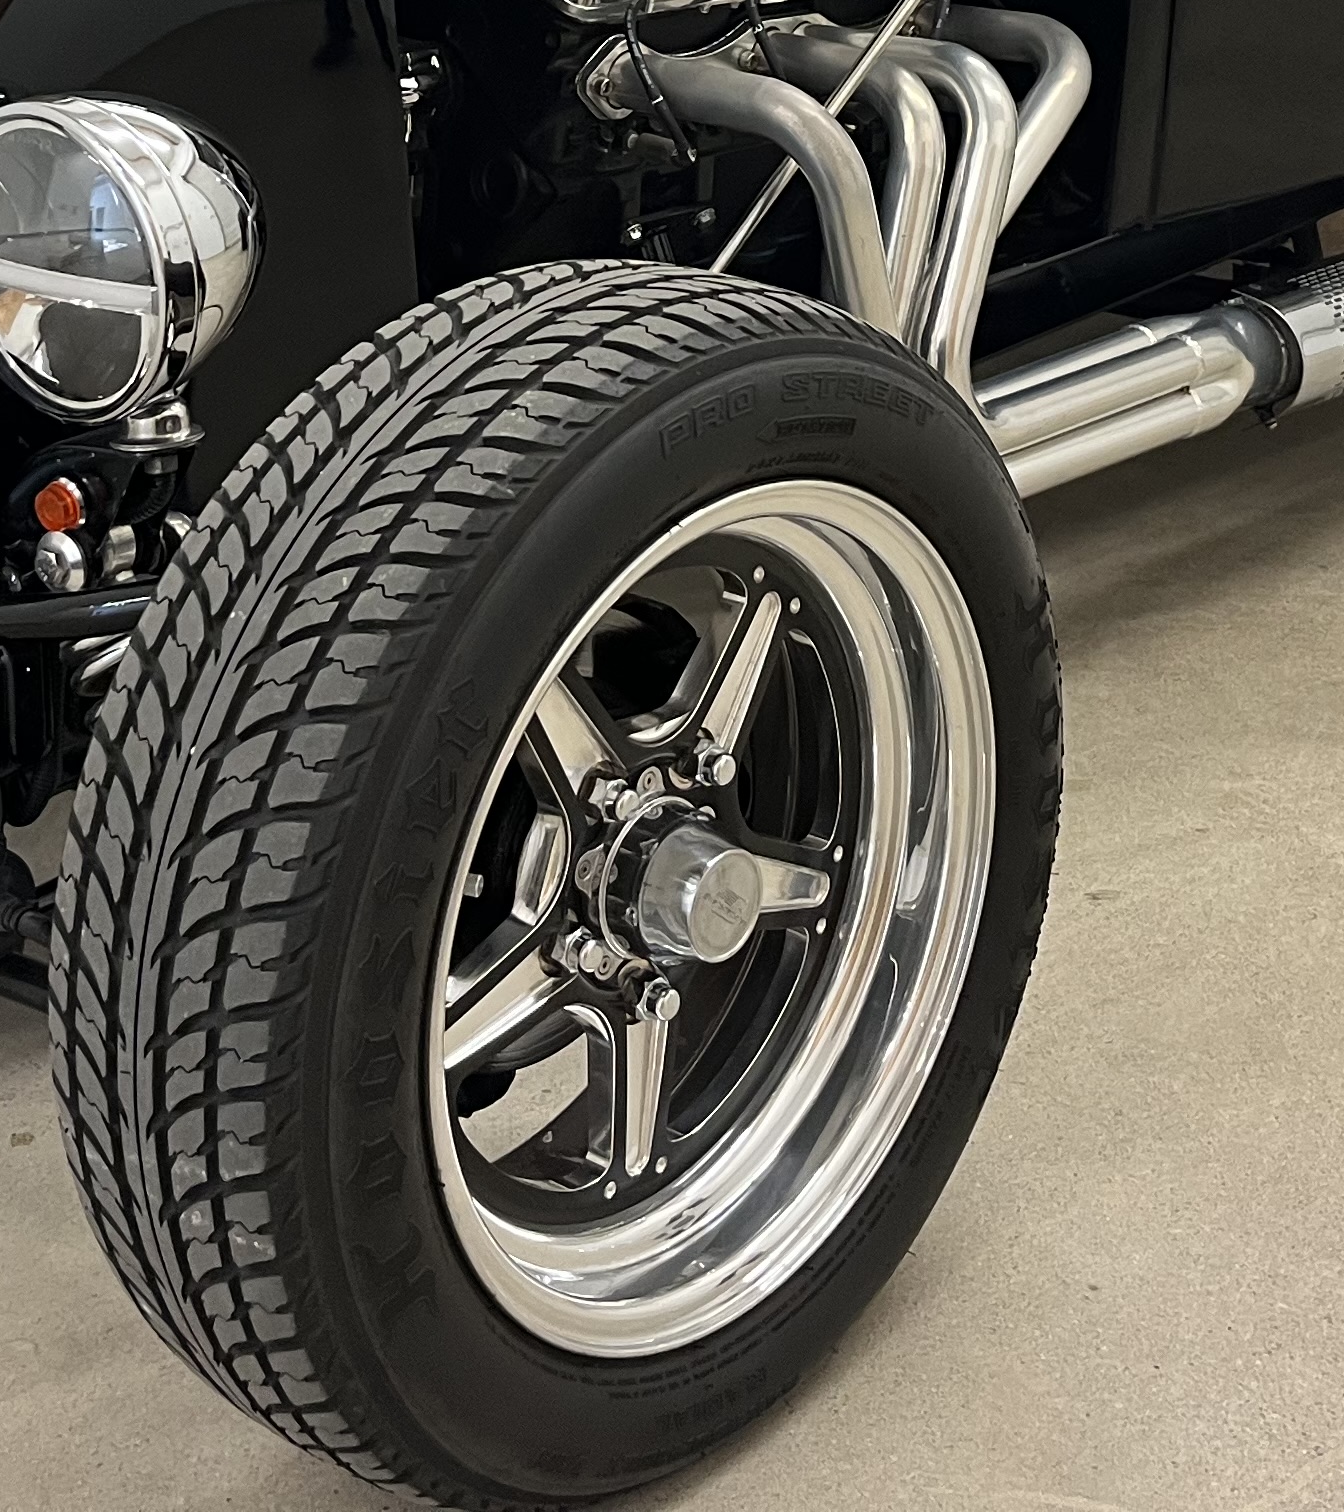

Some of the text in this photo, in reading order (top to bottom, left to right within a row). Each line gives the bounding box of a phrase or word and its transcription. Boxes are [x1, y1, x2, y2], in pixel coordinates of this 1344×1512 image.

[659, 370, 936, 459] PRO STREET
[341, 678, 489, 1324] Hoosier
